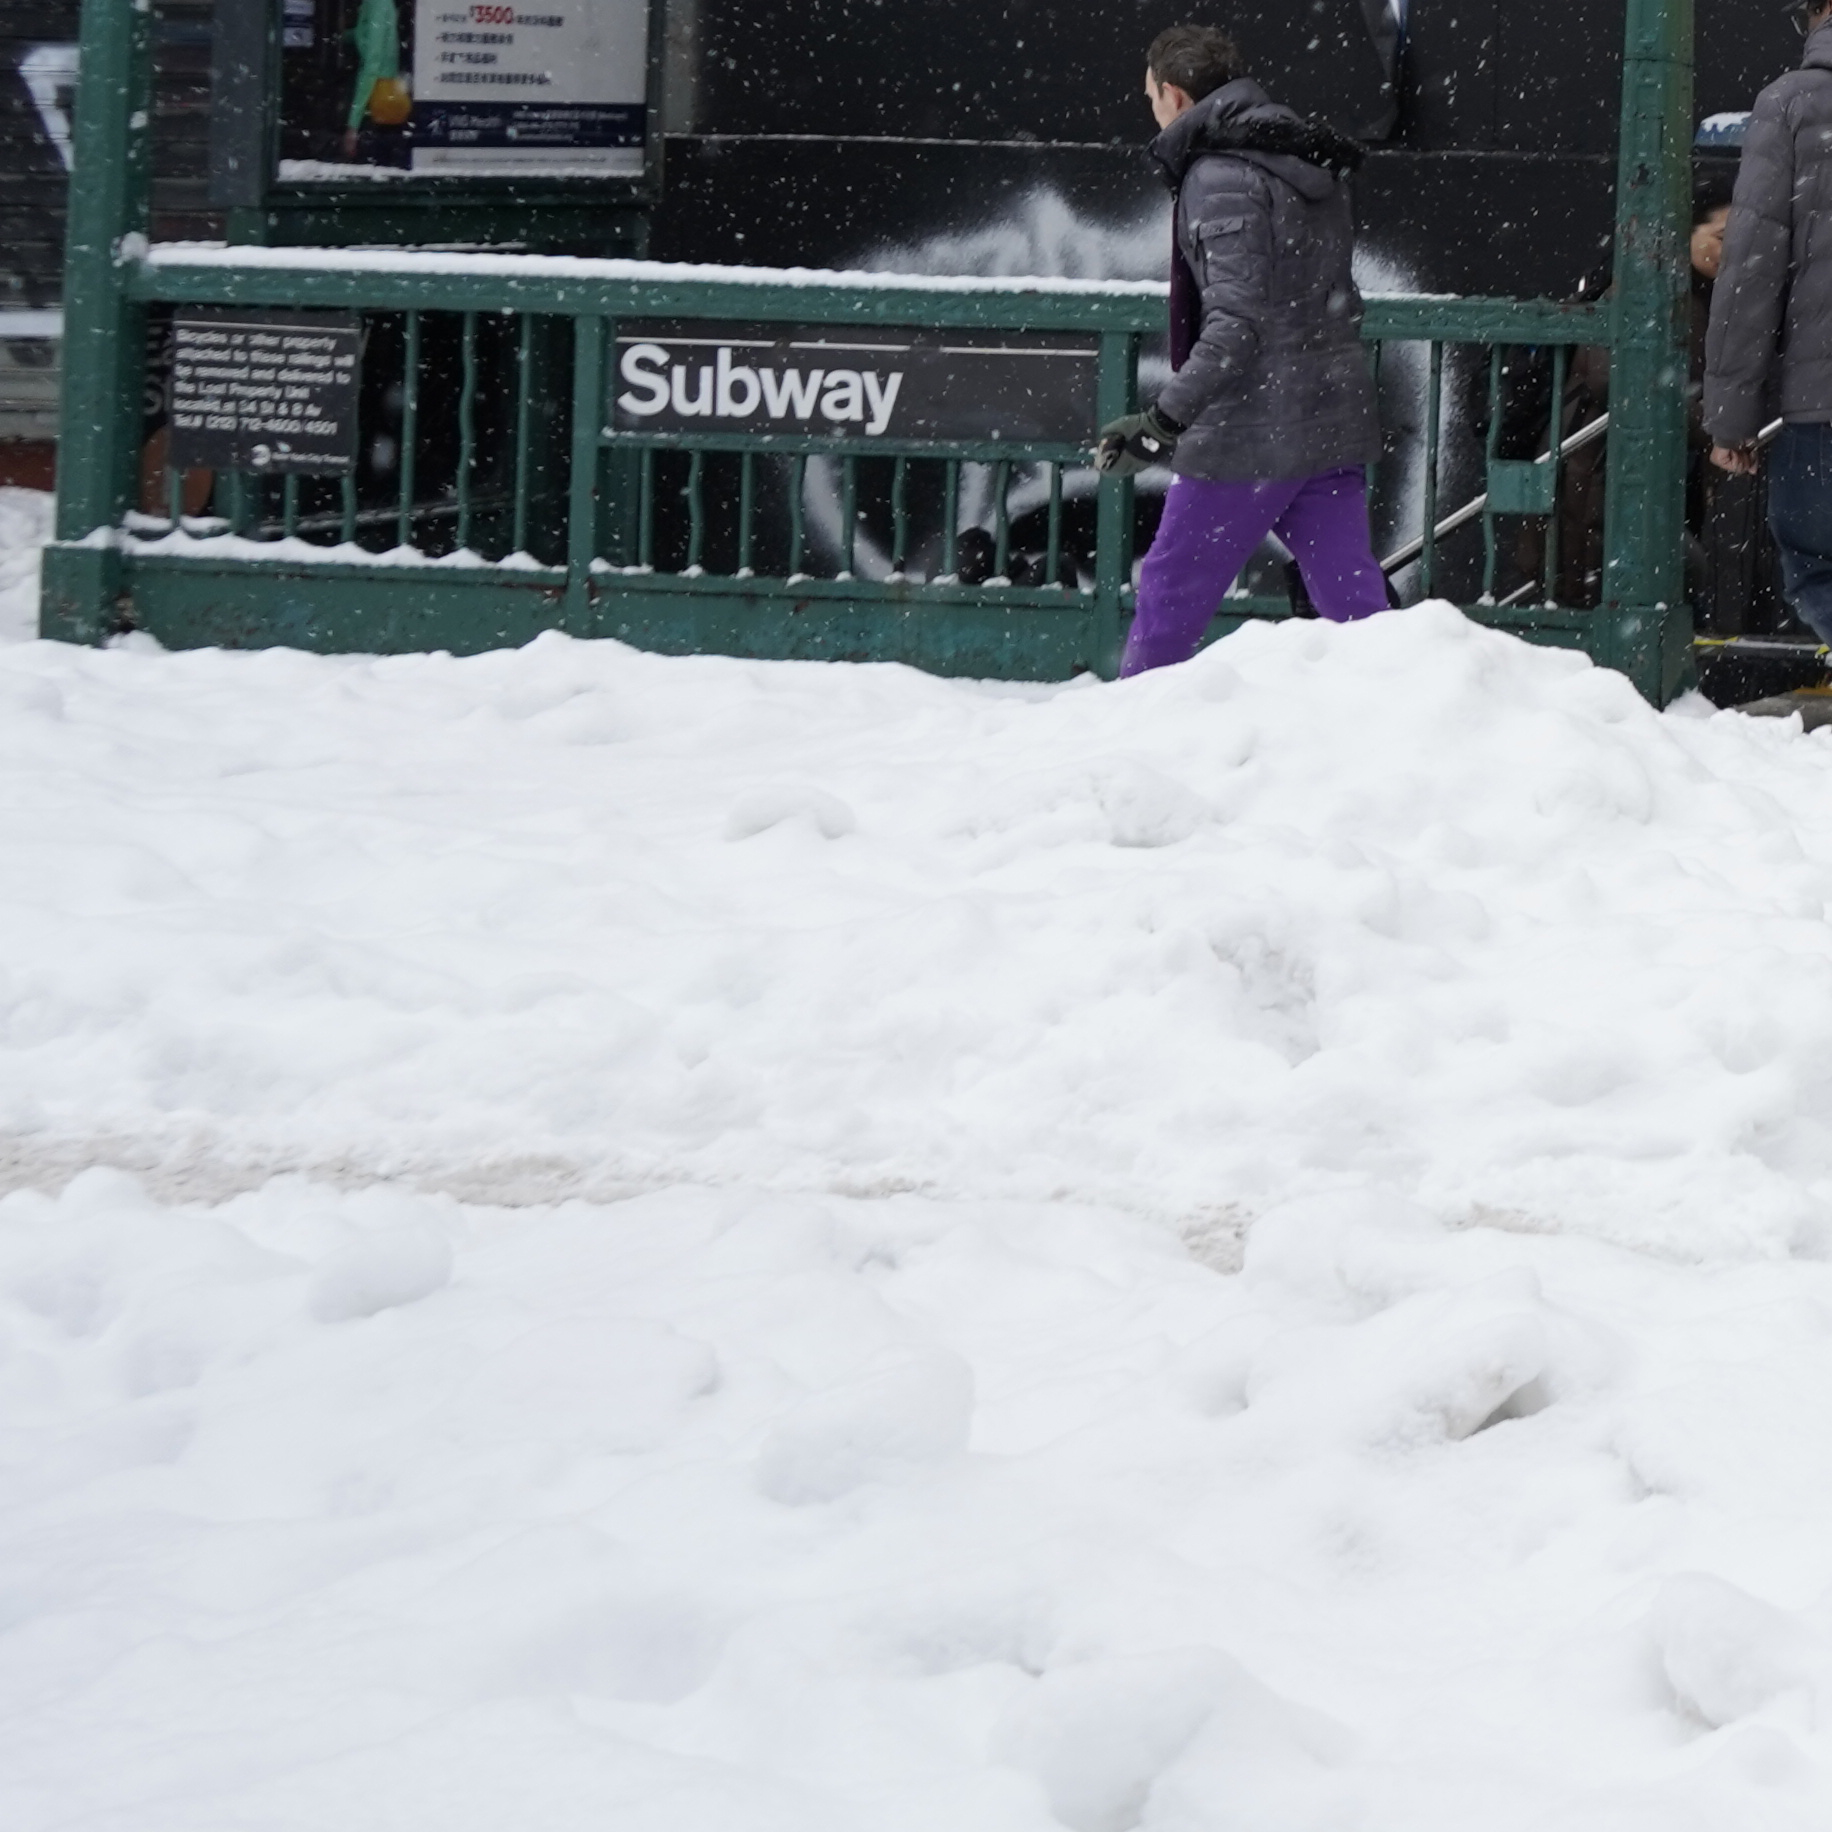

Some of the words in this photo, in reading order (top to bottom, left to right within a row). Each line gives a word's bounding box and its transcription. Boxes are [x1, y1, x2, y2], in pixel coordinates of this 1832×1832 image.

[249, 332, 281, 346] other
[282, 335, 337, 351] property
[175, 347, 231, 362] attached
[232, 349, 248, 362] to
[250, 367, 276, 382] and
[277, 367, 334, 384] delivered
[335, 371, 351, 385] to
[174, 380, 196, 394] the
[197, 380, 228, 396] Lost
[228, 382, 283, 399] Property
[284, 385, 310, 400] Unit
[617, 344, 903, 436] Subway
